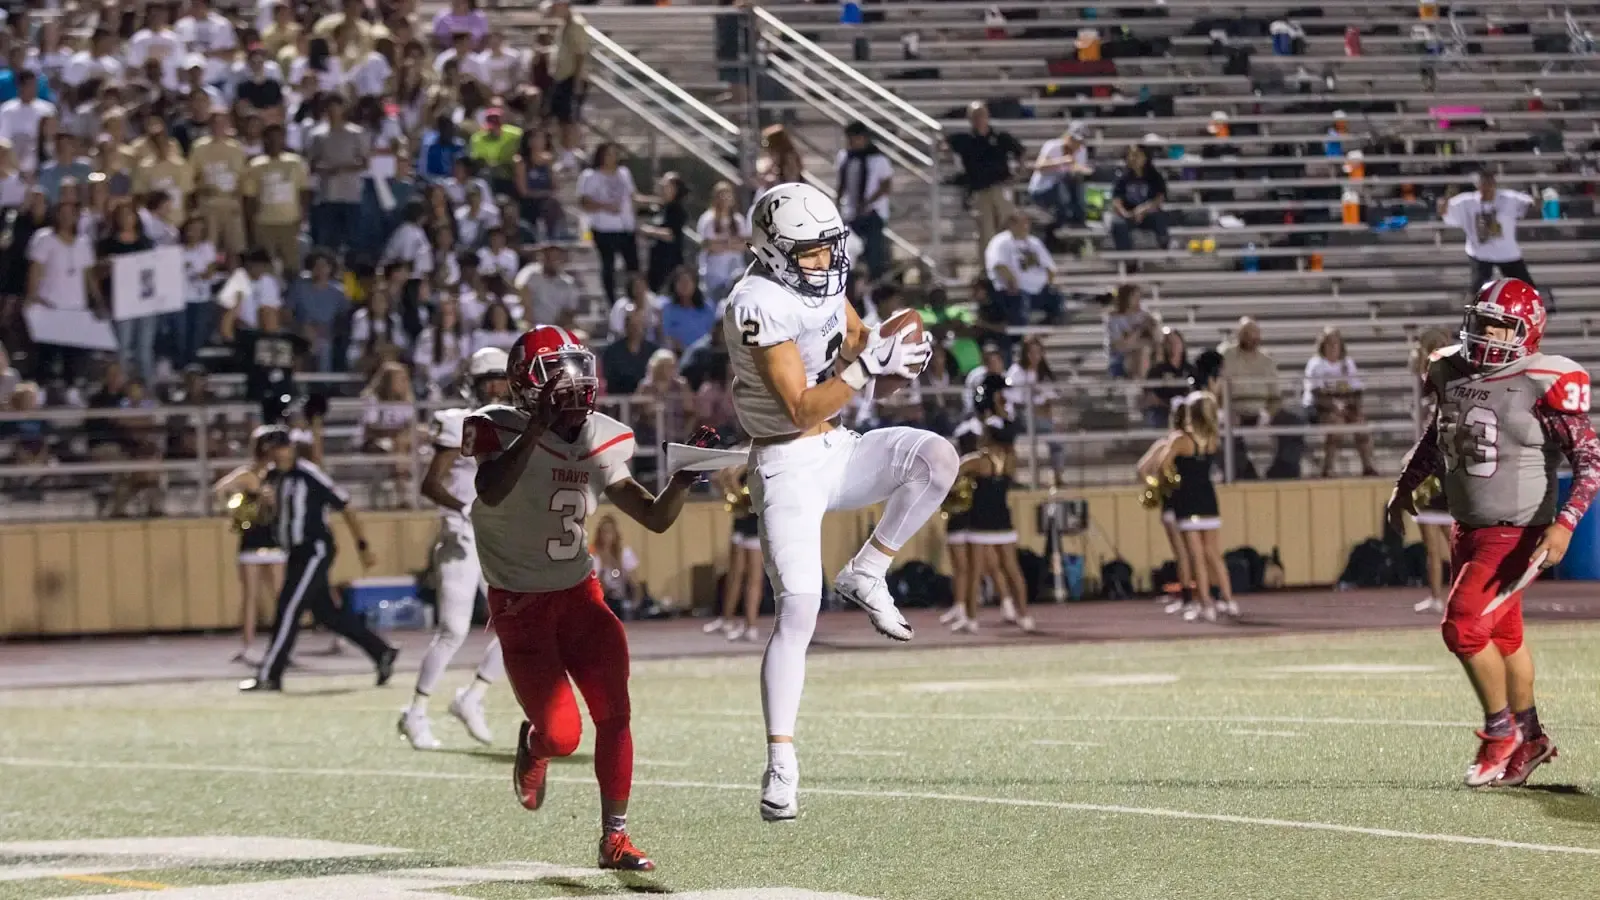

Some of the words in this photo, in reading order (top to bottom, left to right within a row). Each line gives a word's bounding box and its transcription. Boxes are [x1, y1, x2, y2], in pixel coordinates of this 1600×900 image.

[742, 319, 760, 346] 2
[1453, 387, 1491, 401] TRAVIS
[551, 467, 590, 484] TRAVIS
[545, 487, 587, 561] 3
